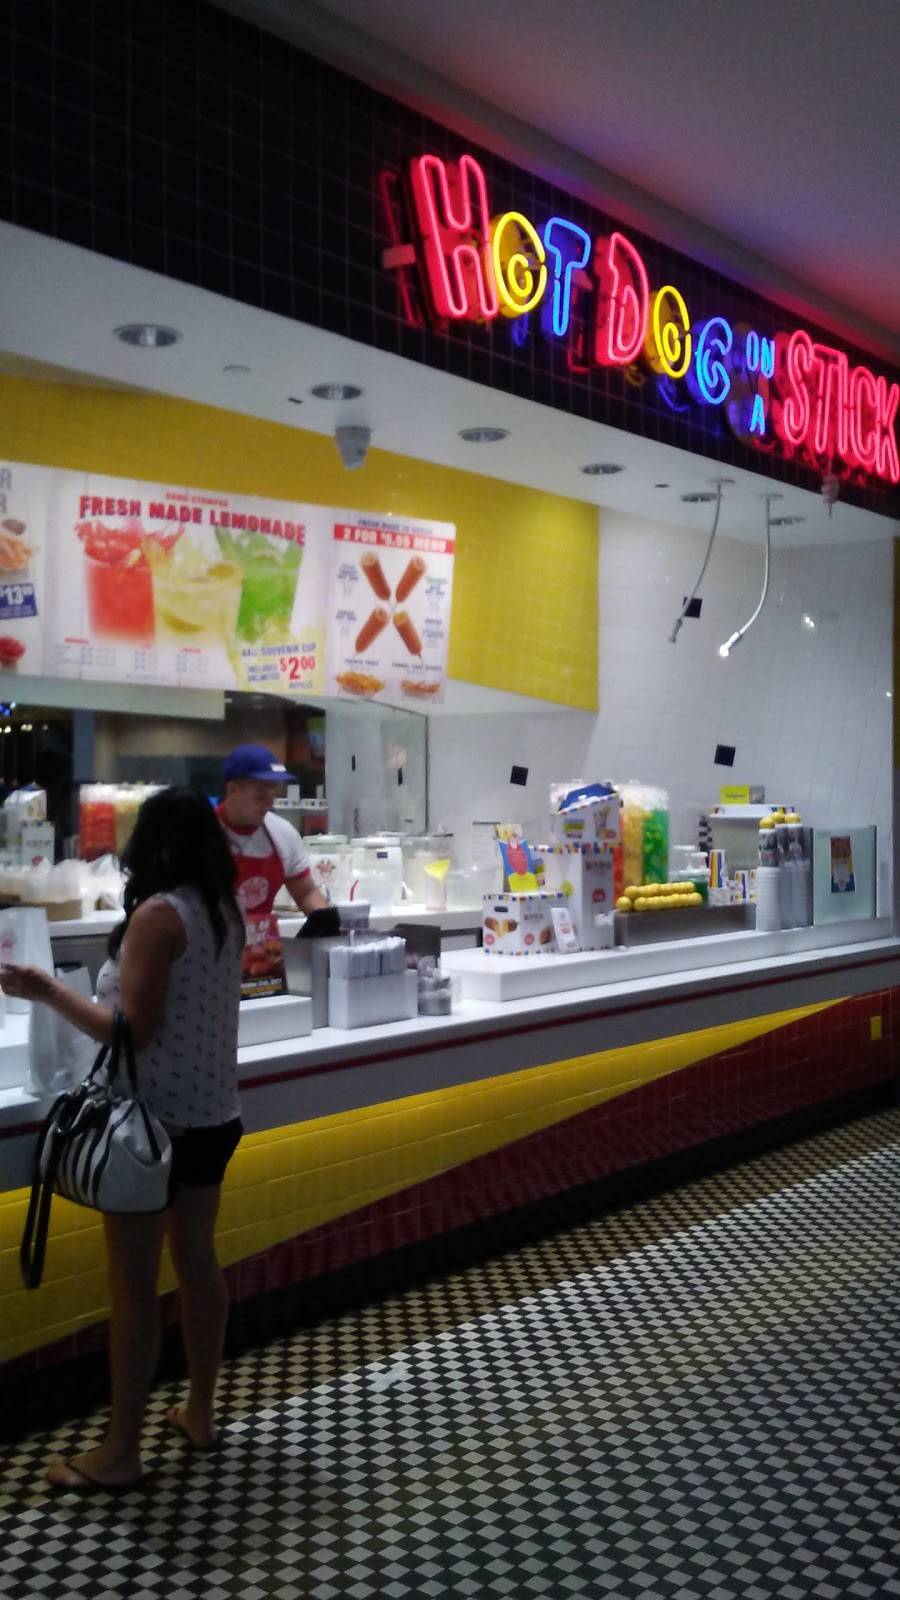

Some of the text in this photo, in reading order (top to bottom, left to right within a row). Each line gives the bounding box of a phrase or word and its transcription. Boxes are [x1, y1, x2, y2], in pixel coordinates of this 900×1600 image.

[414, 153, 900, 484] HOT DOG ON A STICK
[79, 495, 306, 546] FRESH MADE LEMONADE
[343, 527, 352, 540] 2
[354, 529, 378, 543] FOR
[413, 537, 448, 553] MENU
